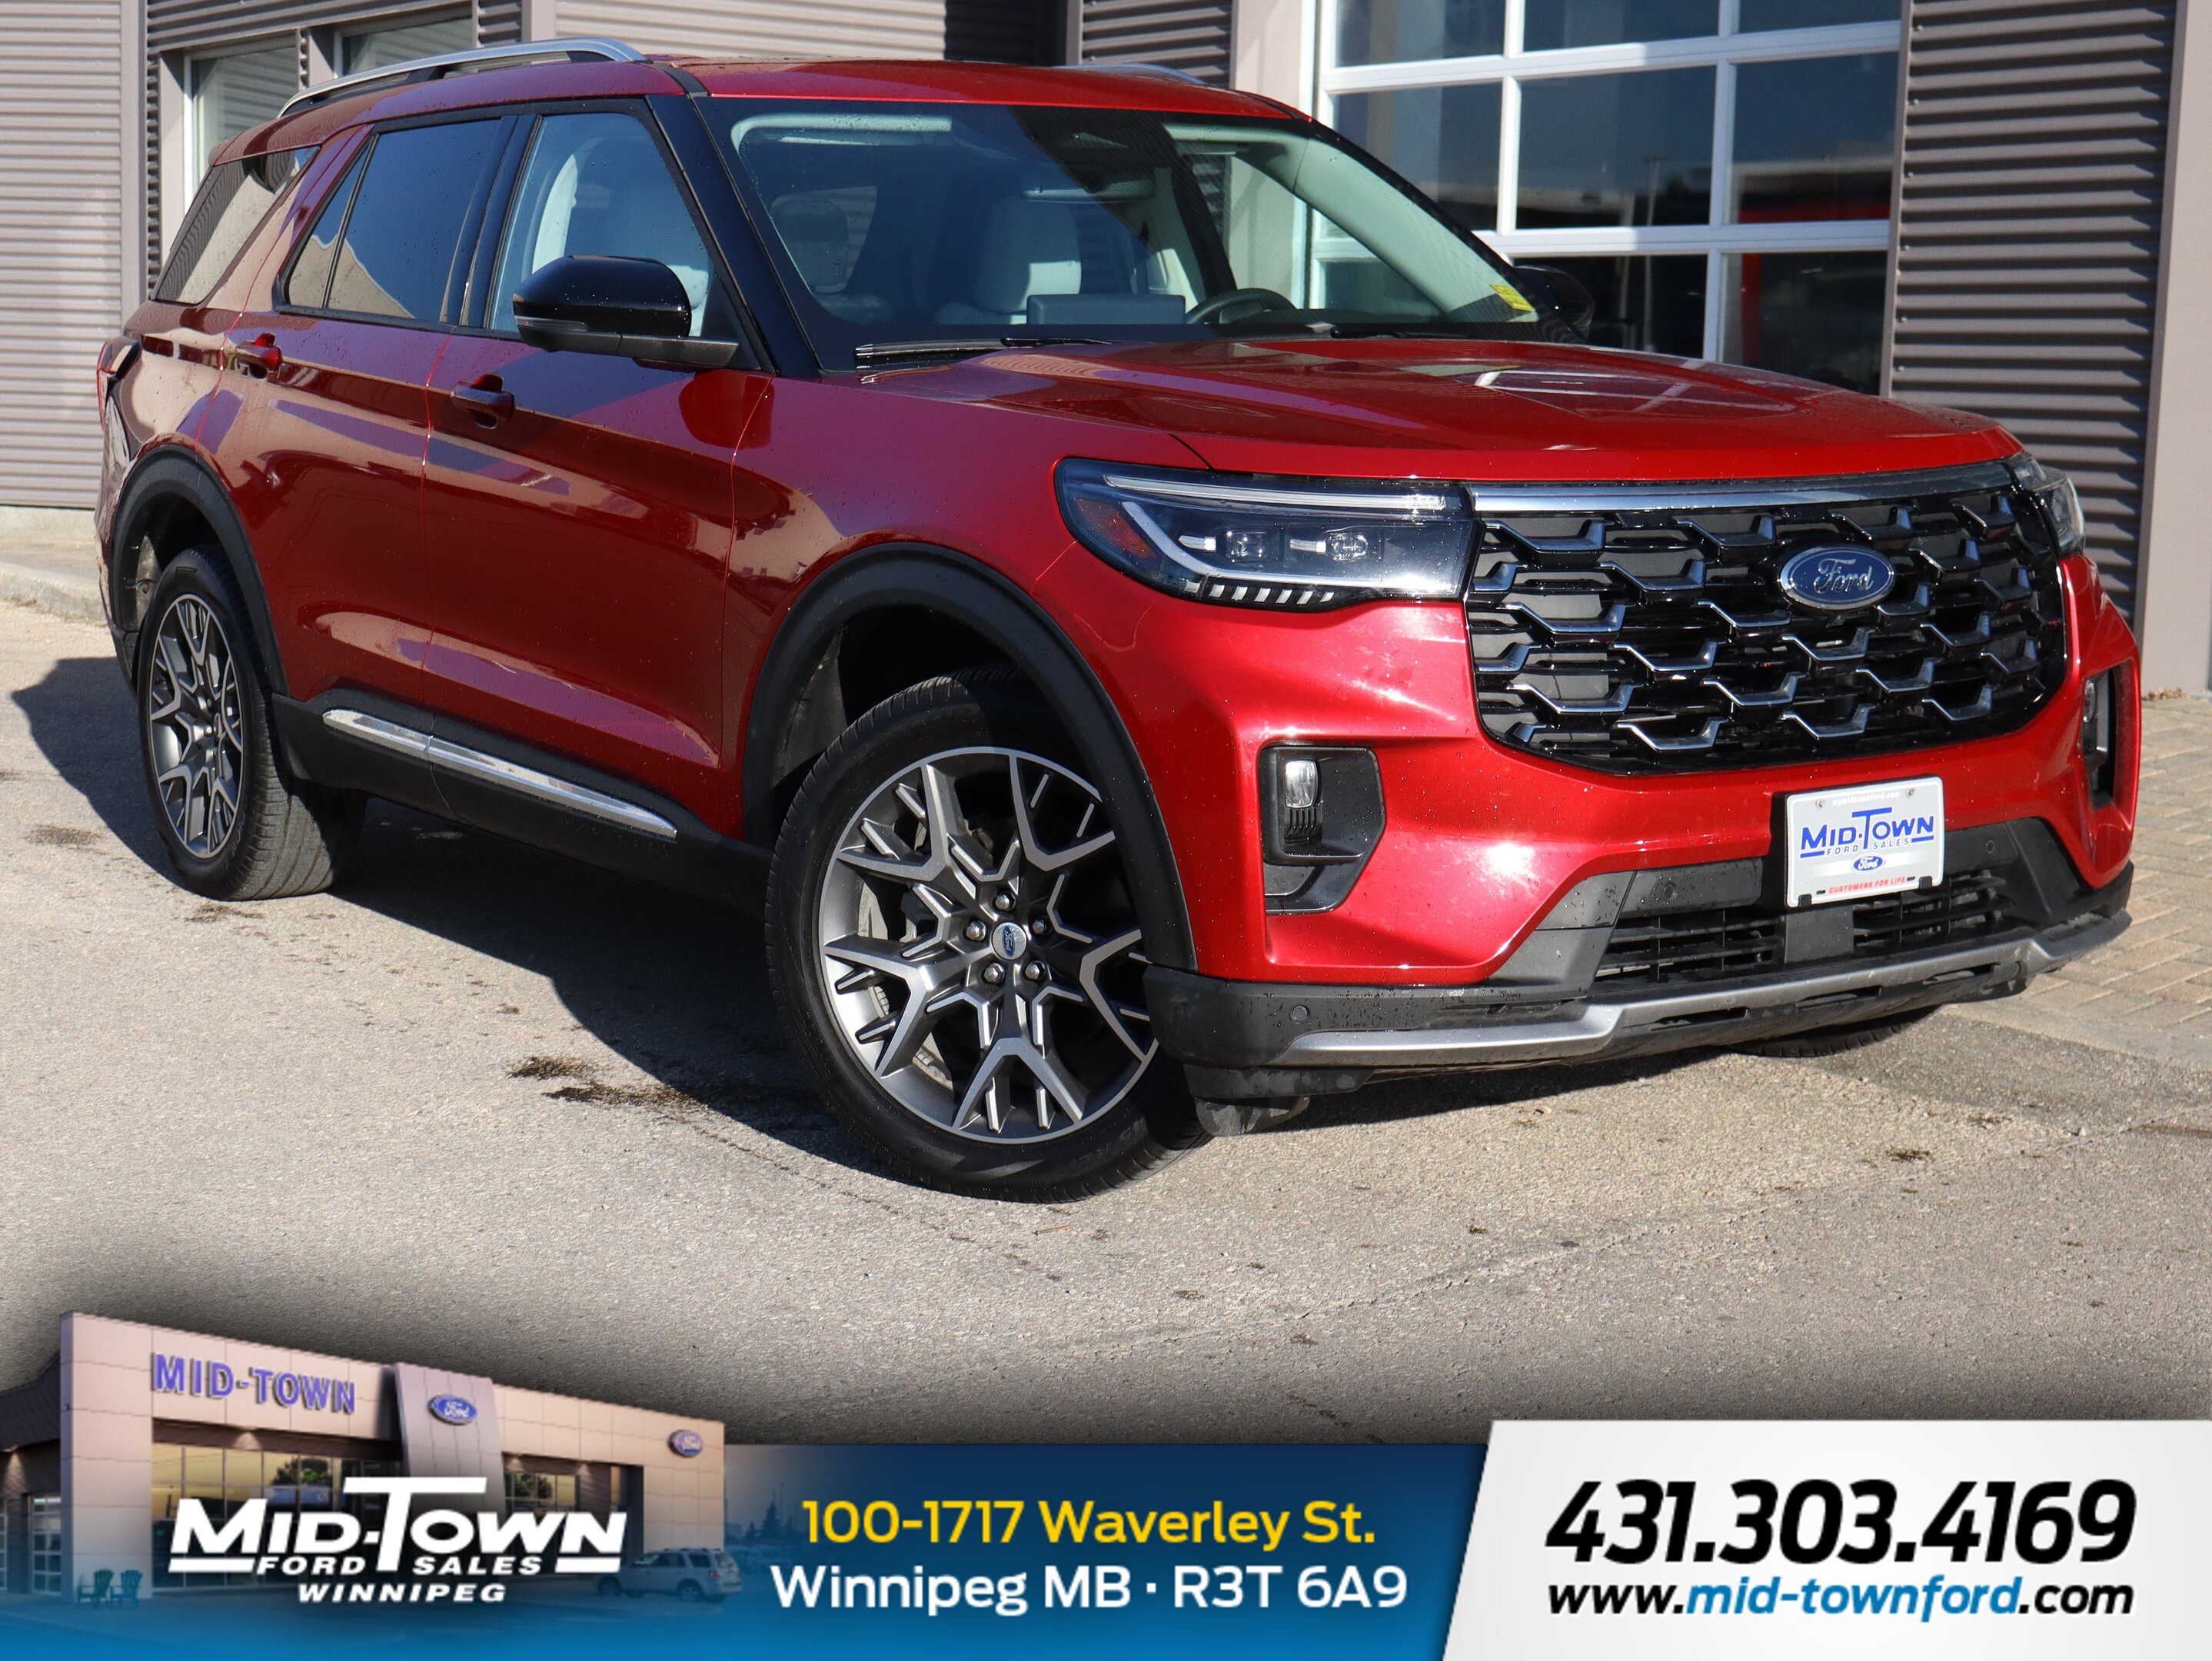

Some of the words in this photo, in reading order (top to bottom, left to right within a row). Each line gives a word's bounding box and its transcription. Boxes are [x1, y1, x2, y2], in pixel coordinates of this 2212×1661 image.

[1813, 558, 1874, 594] Ford
[1827, 844, 1859, 856] FORD
[1873, 837, 1910, 850] SALES
[1858, 857, 1879, 870] Ford
[1828, 880, 1874, 894] CUSTOMERS
[1874, 878, 1889, 888] FOR
[1890, 876, 1906, 885] LIFE
